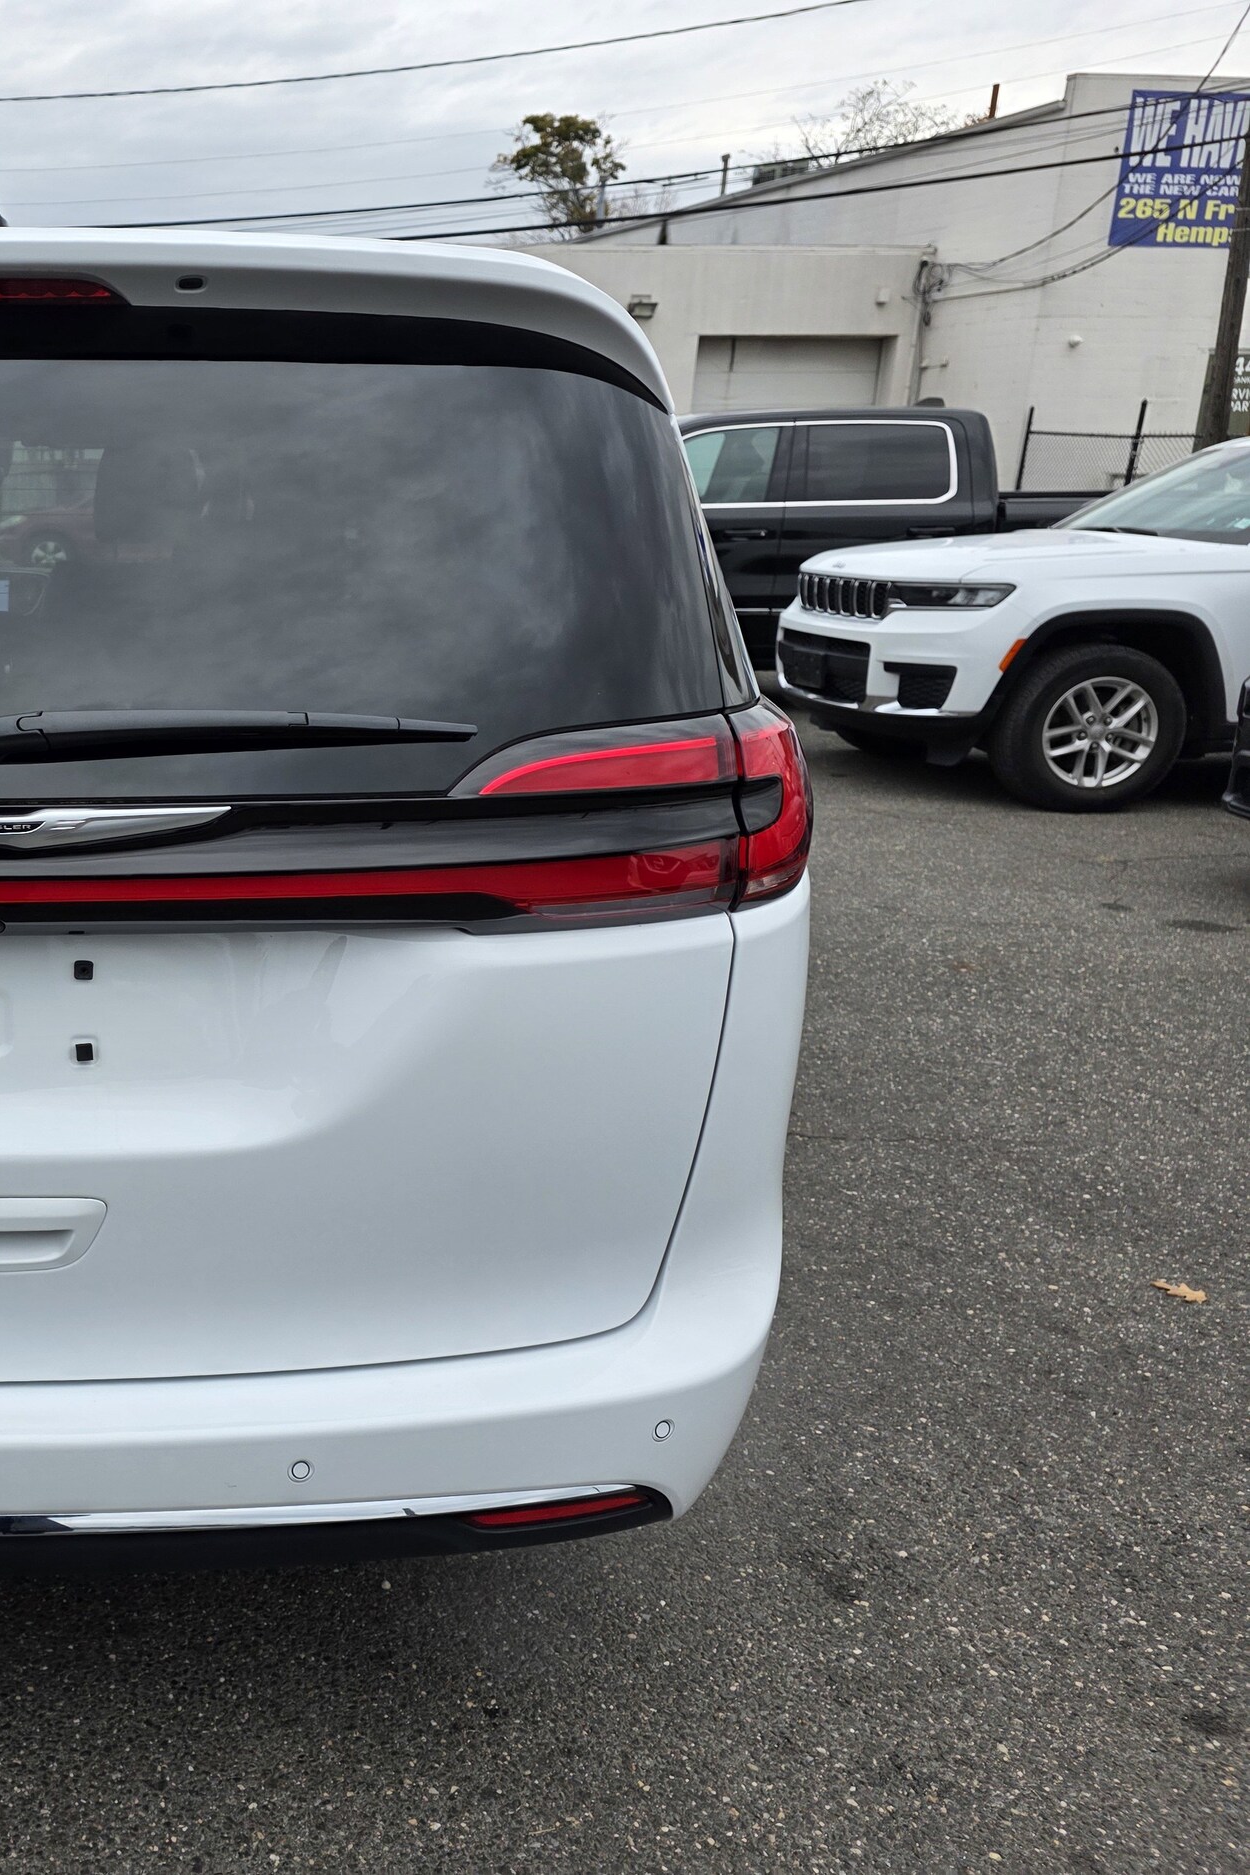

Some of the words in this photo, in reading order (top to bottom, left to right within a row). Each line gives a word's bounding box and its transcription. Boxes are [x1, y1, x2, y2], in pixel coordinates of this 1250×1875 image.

[1128, 97, 1181, 167] WE
[1128, 172, 1157, 183] WE
[1161, 174, 1196, 185] ARE
[1200, 175, 1242, 186] NOW
[1123, 183, 1156, 195] THE
[1160, 185, 1201, 196] NEW
[1117, 197, 1171, 219] 265
[1177, 199, 1198, 220] N
[1204, 199, 1236, 220] Fr
